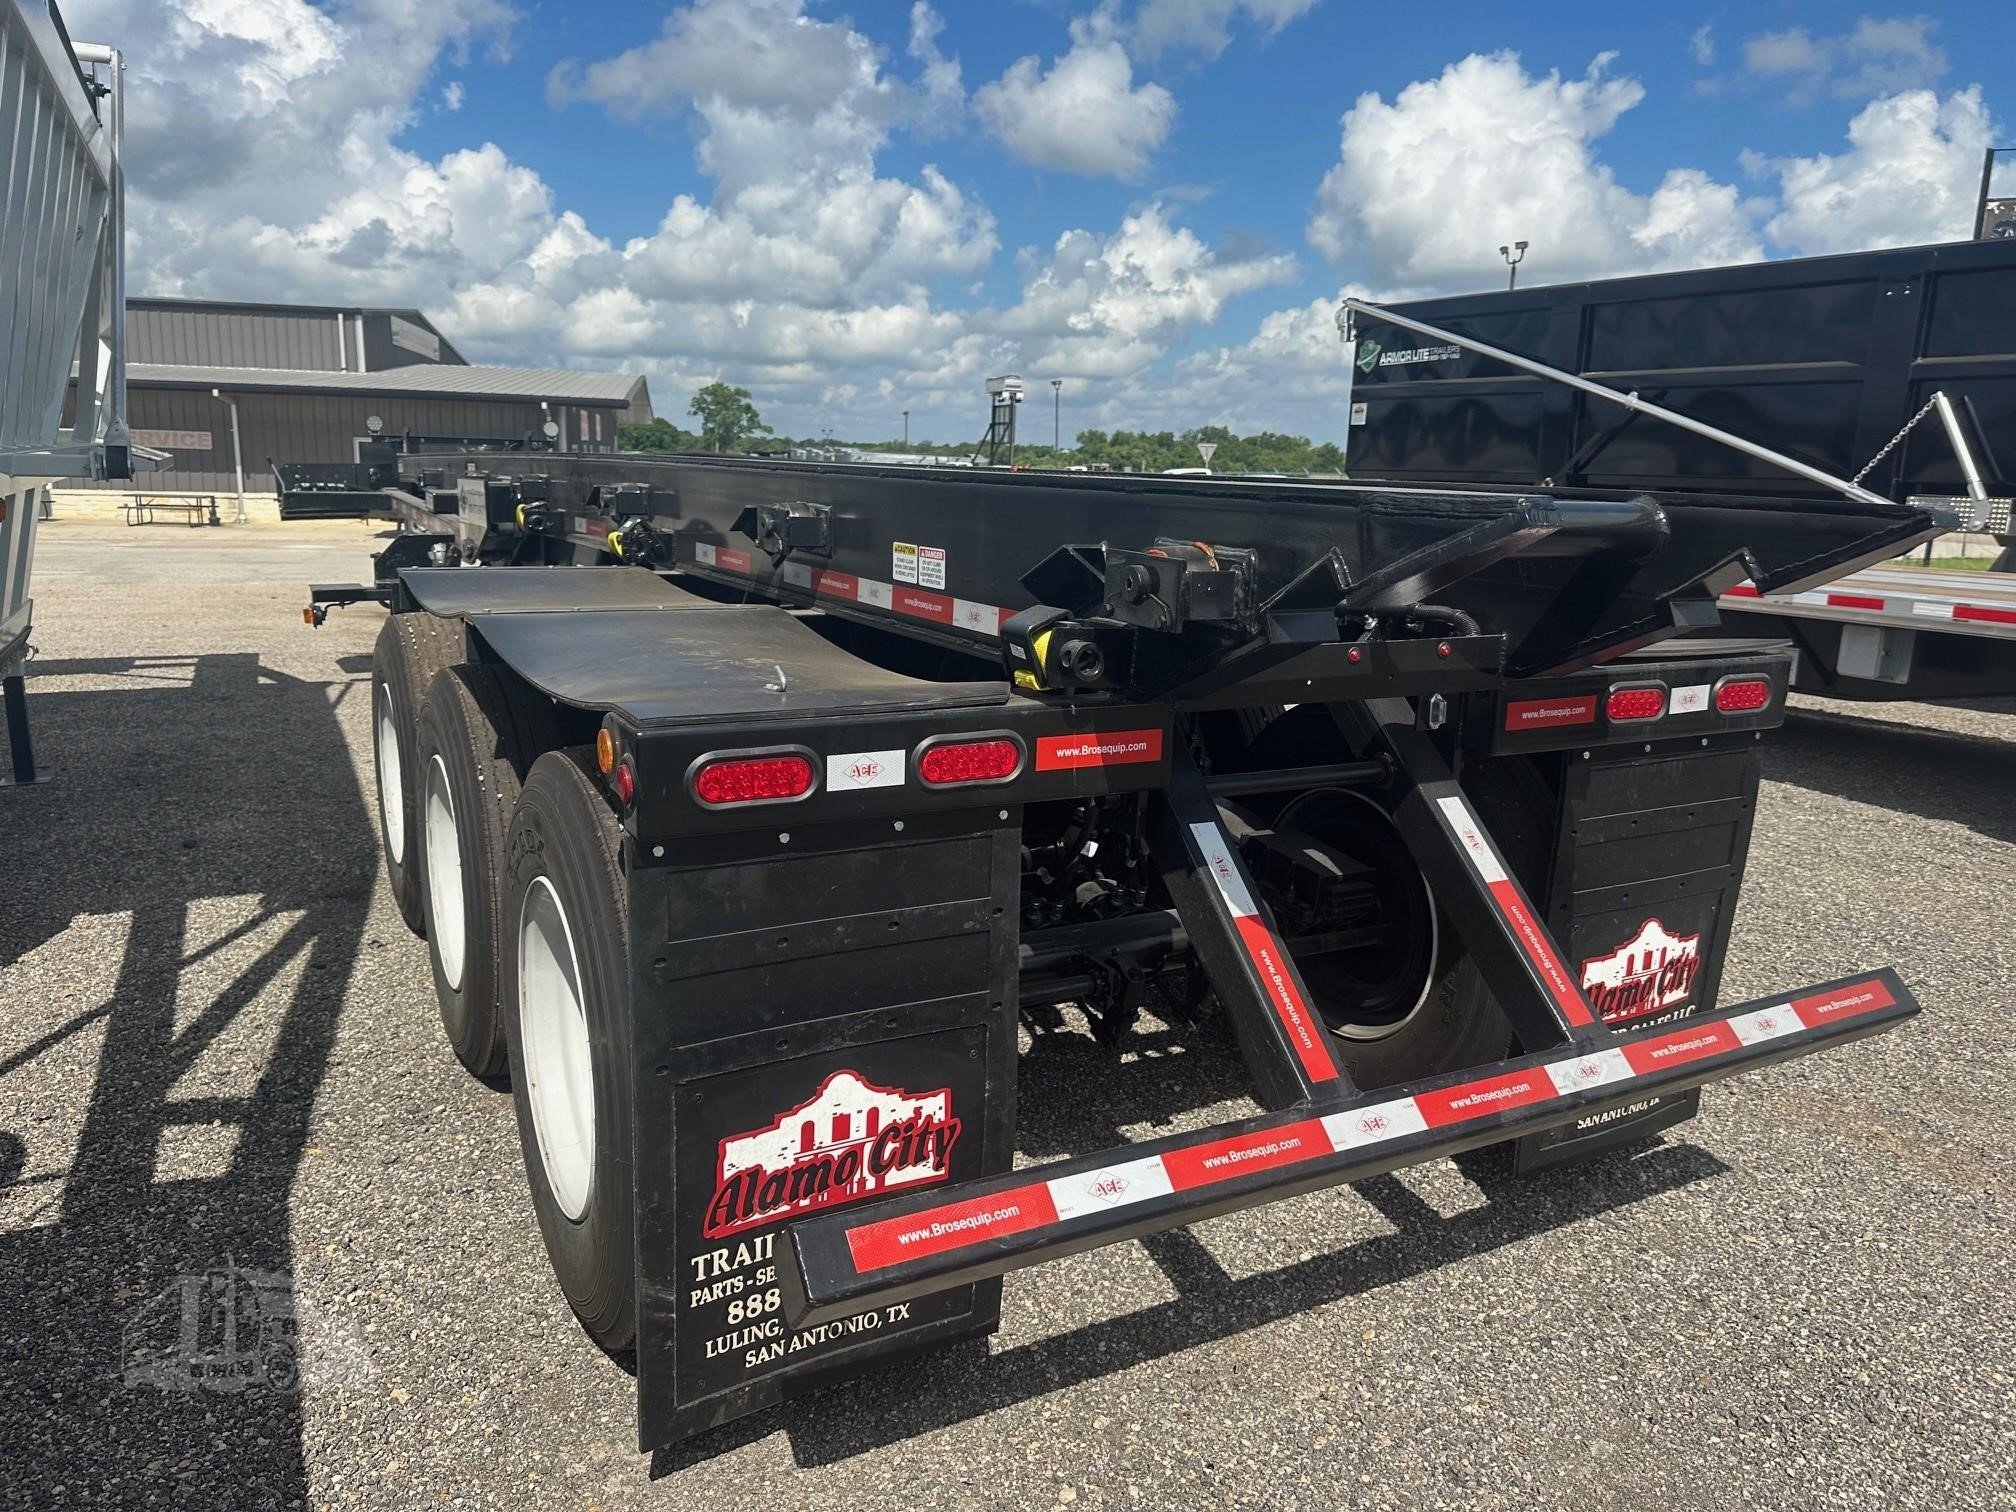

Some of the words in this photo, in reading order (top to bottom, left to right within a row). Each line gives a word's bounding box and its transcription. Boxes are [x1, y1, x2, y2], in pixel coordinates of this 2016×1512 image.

[1380, 349, 1412, 364] ARMOR
[1413, 347, 1430, 361] LITE
[1430, 345, 1460, 354] TRAILERS
[130, 432, 210, 447] ERVICE
[897, 544, 916, 555] CAUTION
[925, 550, 943, 559] DANGER
[1521, 705, 1586, 720] www.Brosequip.com
[1056, 740, 1147, 758] www.Brosequip.com
[849, 762, 878, 778] ACE
[1510, 904, 1567, 993] www.Brosequip.com
[1656, 952, 1700, 998] City
[1259, 948, 1314, 1050] www.Brosequip.com
[1650, 1034, 1719, 1060] www.Brosequip.com
[1449, 1082, 1531, 1110] www.Brosequip.com
[1361, 1116, 1386, 1132] ACE
[1202, 1136, 1301, 1169] www.Brosequip.com
[704, 1147, 860, 1233] Alamo
[869, 1114, 962, 1175] City
[1095, 1178, 1124, 1197] ACE
[898, 1204, 1021, 1246] www.Brosequip.com
[690, 1275, 744, 1308] PARTS
[705, 1318, 785, 1358] LULING,
[745, 1339, 785, 1368] SAN
[787, 1312, 883, 1354] ANTONIO,
[886, 1302, 911, 1324] TX
